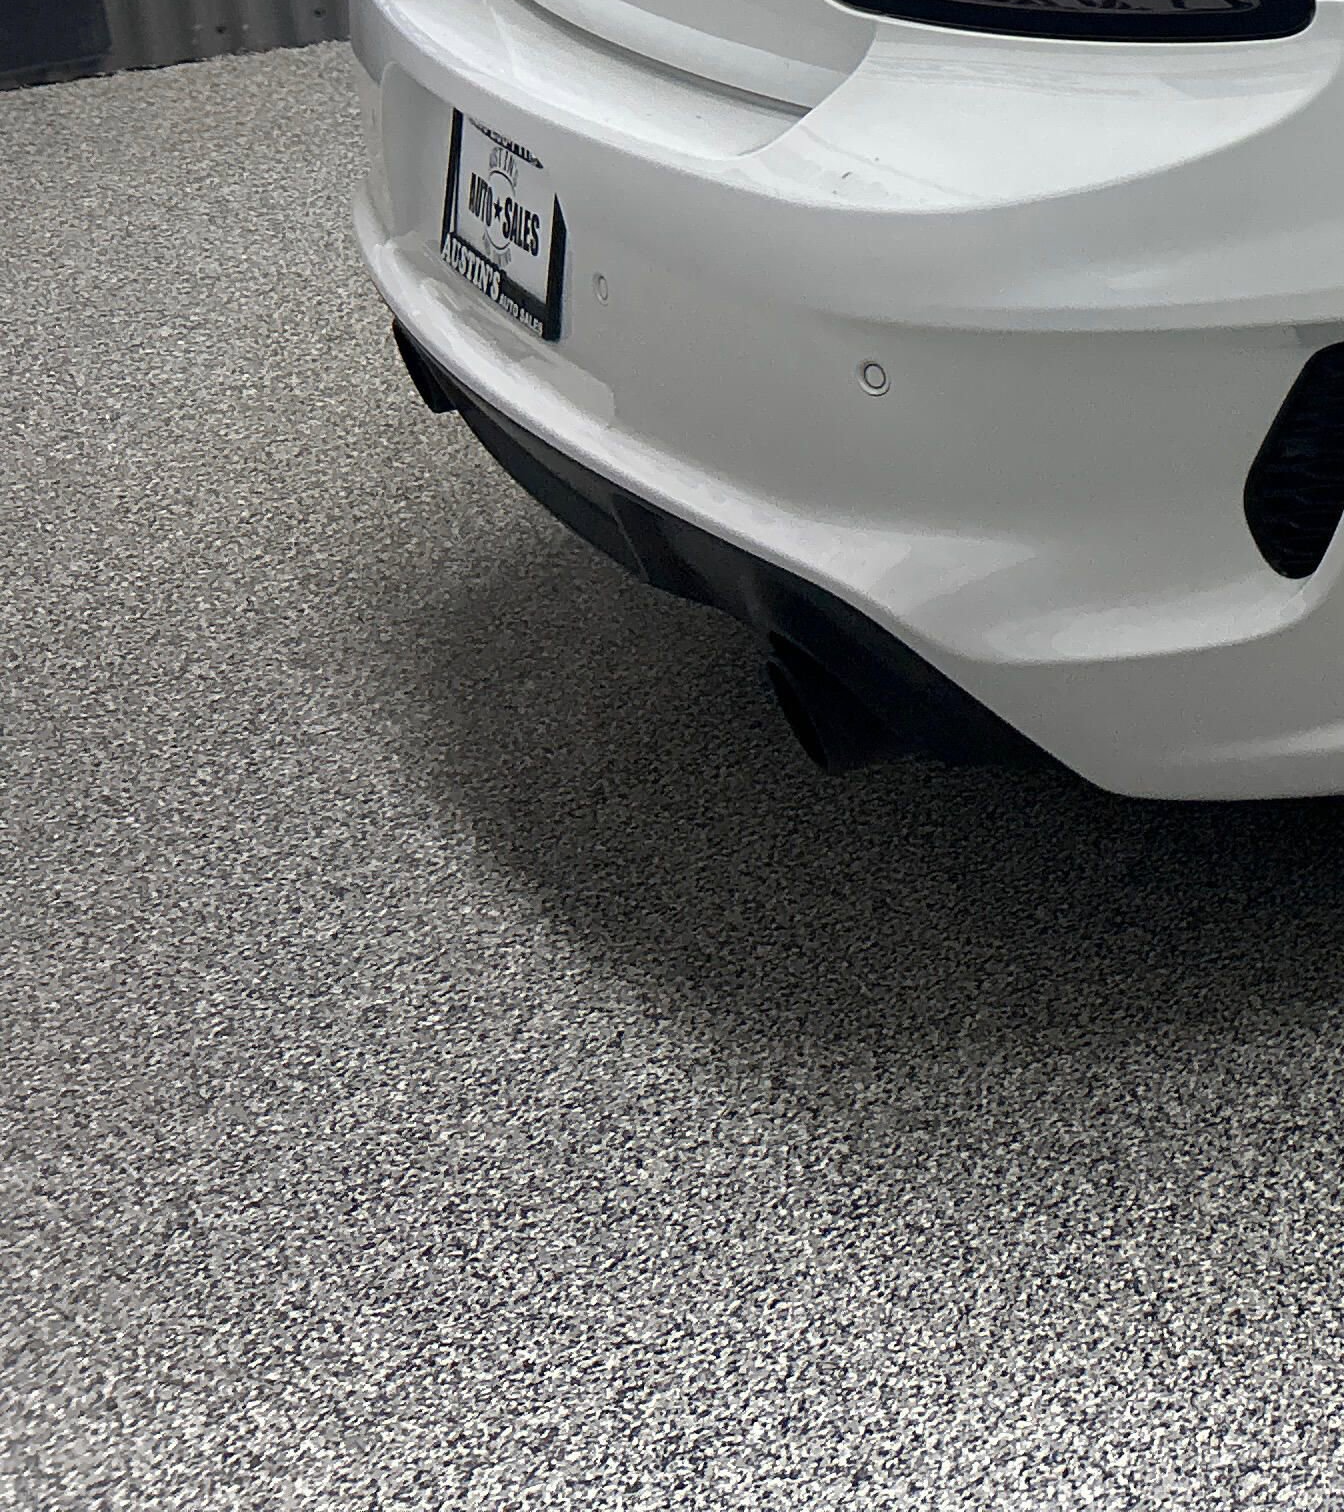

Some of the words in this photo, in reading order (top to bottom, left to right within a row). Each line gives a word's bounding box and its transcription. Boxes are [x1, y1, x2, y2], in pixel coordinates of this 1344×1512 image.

[468, 172, 493, 227] AUTO
[502, 196, 540, 256] SALES
[441, 233, 501, 301] AUSTIN'S
